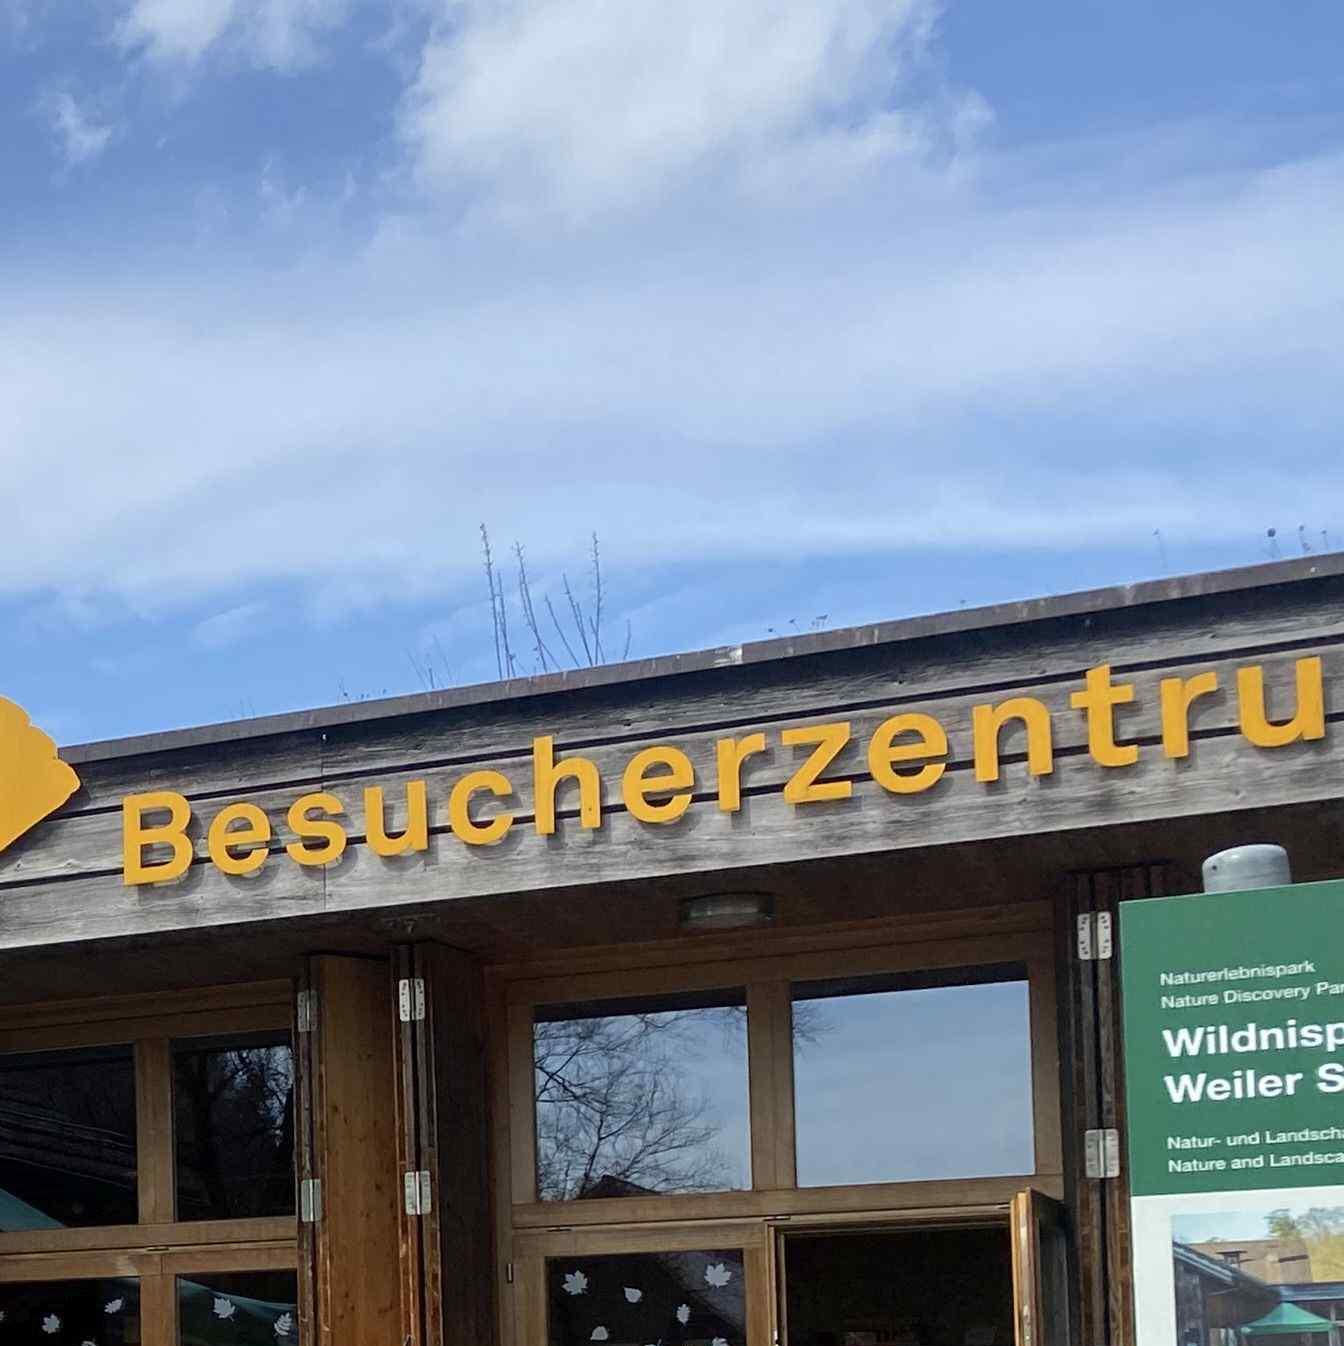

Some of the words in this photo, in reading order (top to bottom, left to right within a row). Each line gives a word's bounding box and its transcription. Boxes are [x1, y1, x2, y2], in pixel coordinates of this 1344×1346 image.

[123, 656, 1325, 887] Besucherzentru
[1160, 960, 1315, 986] Naturerlebnispark
[1161, 993, 1218, 1009] Nature
[1224, 985, 1310, 1005] Discovery
[1164, 1069, 1303, 1104] Weiler
[1167, 1135, 1221, 1150] Natur-
[1227, 1132, 1260, 1147] und
[1168, 1156, 1227, 1173] Nature
[1231, 1155, 1264, 1169] and
